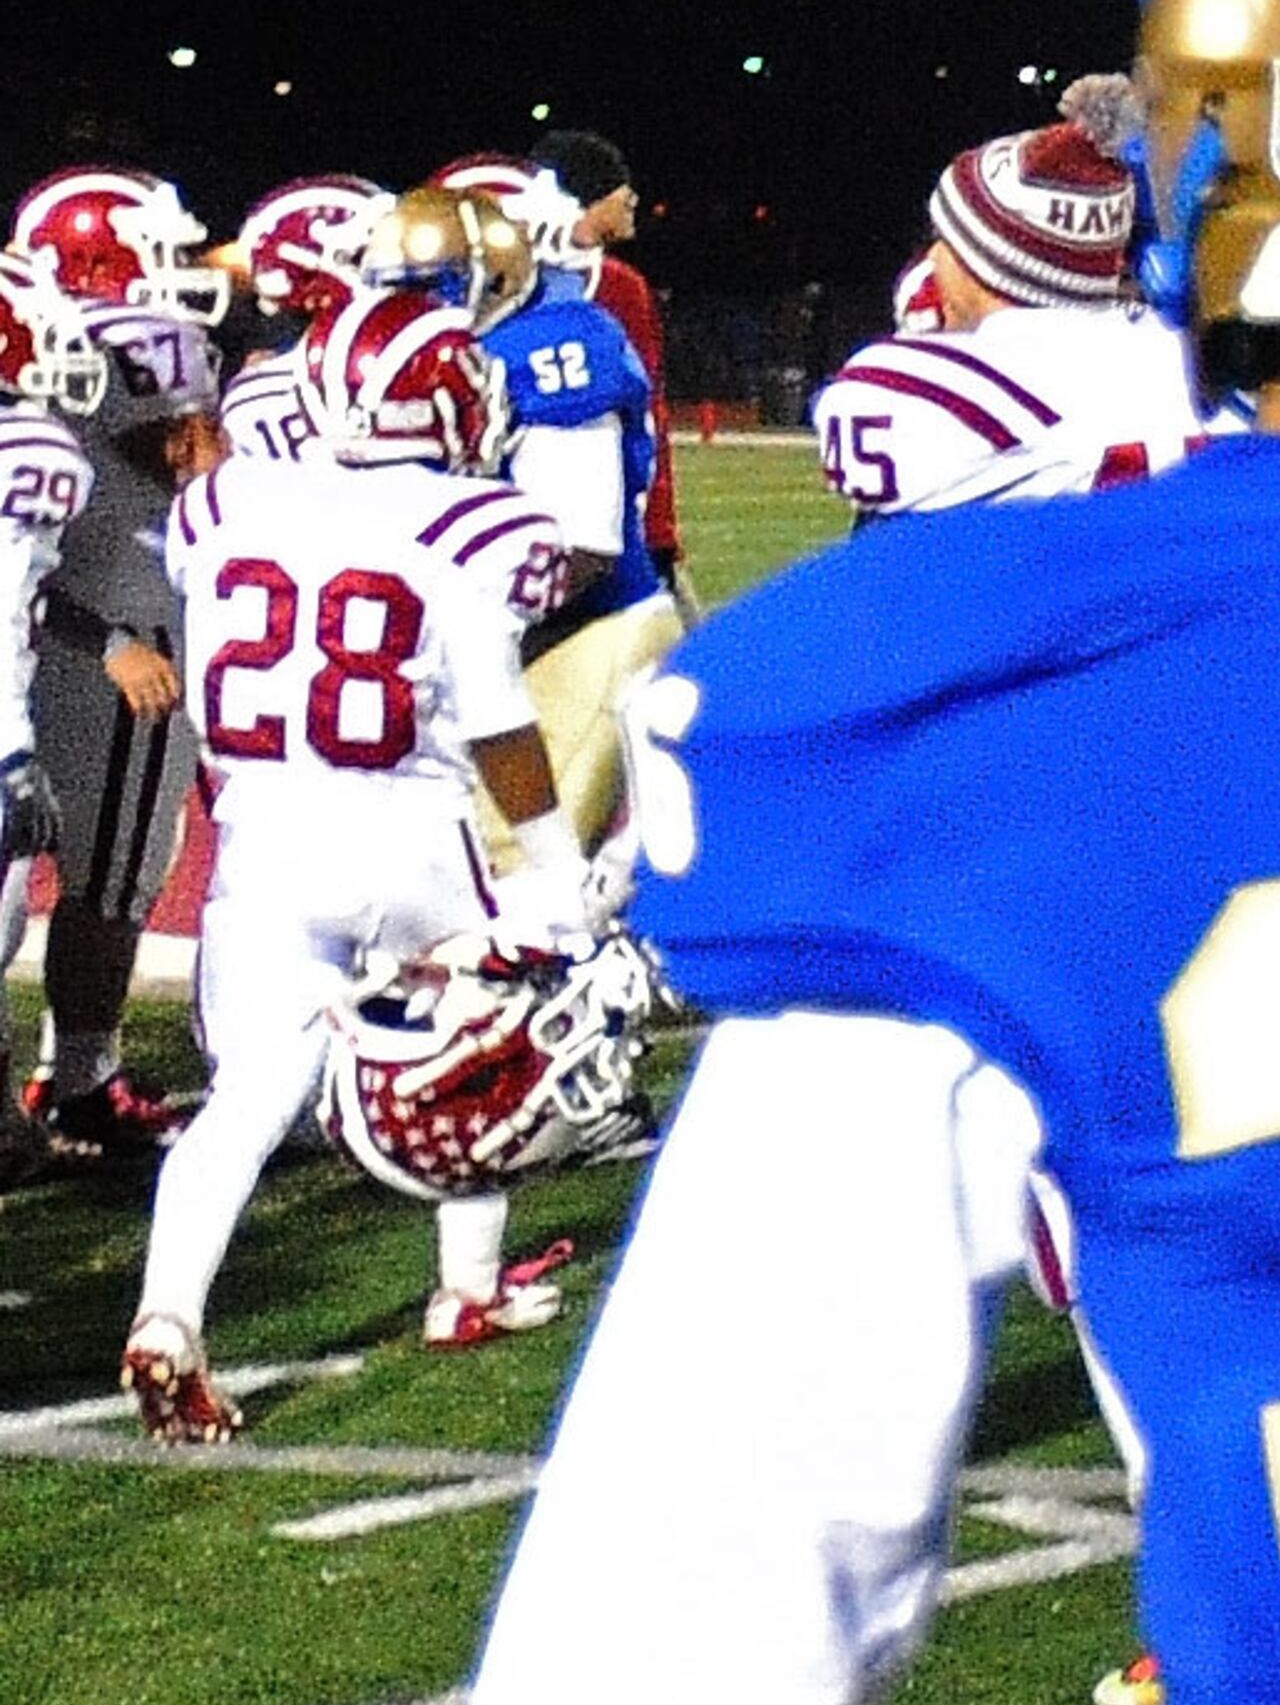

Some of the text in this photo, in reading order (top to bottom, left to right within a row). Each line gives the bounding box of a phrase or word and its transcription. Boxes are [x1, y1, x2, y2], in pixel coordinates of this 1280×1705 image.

[528, 340, 591, 394] 52
[1, 464, 78, 527] 29
[823, 415, 899, 503] 45
[204, 557, 425, 770] 28
